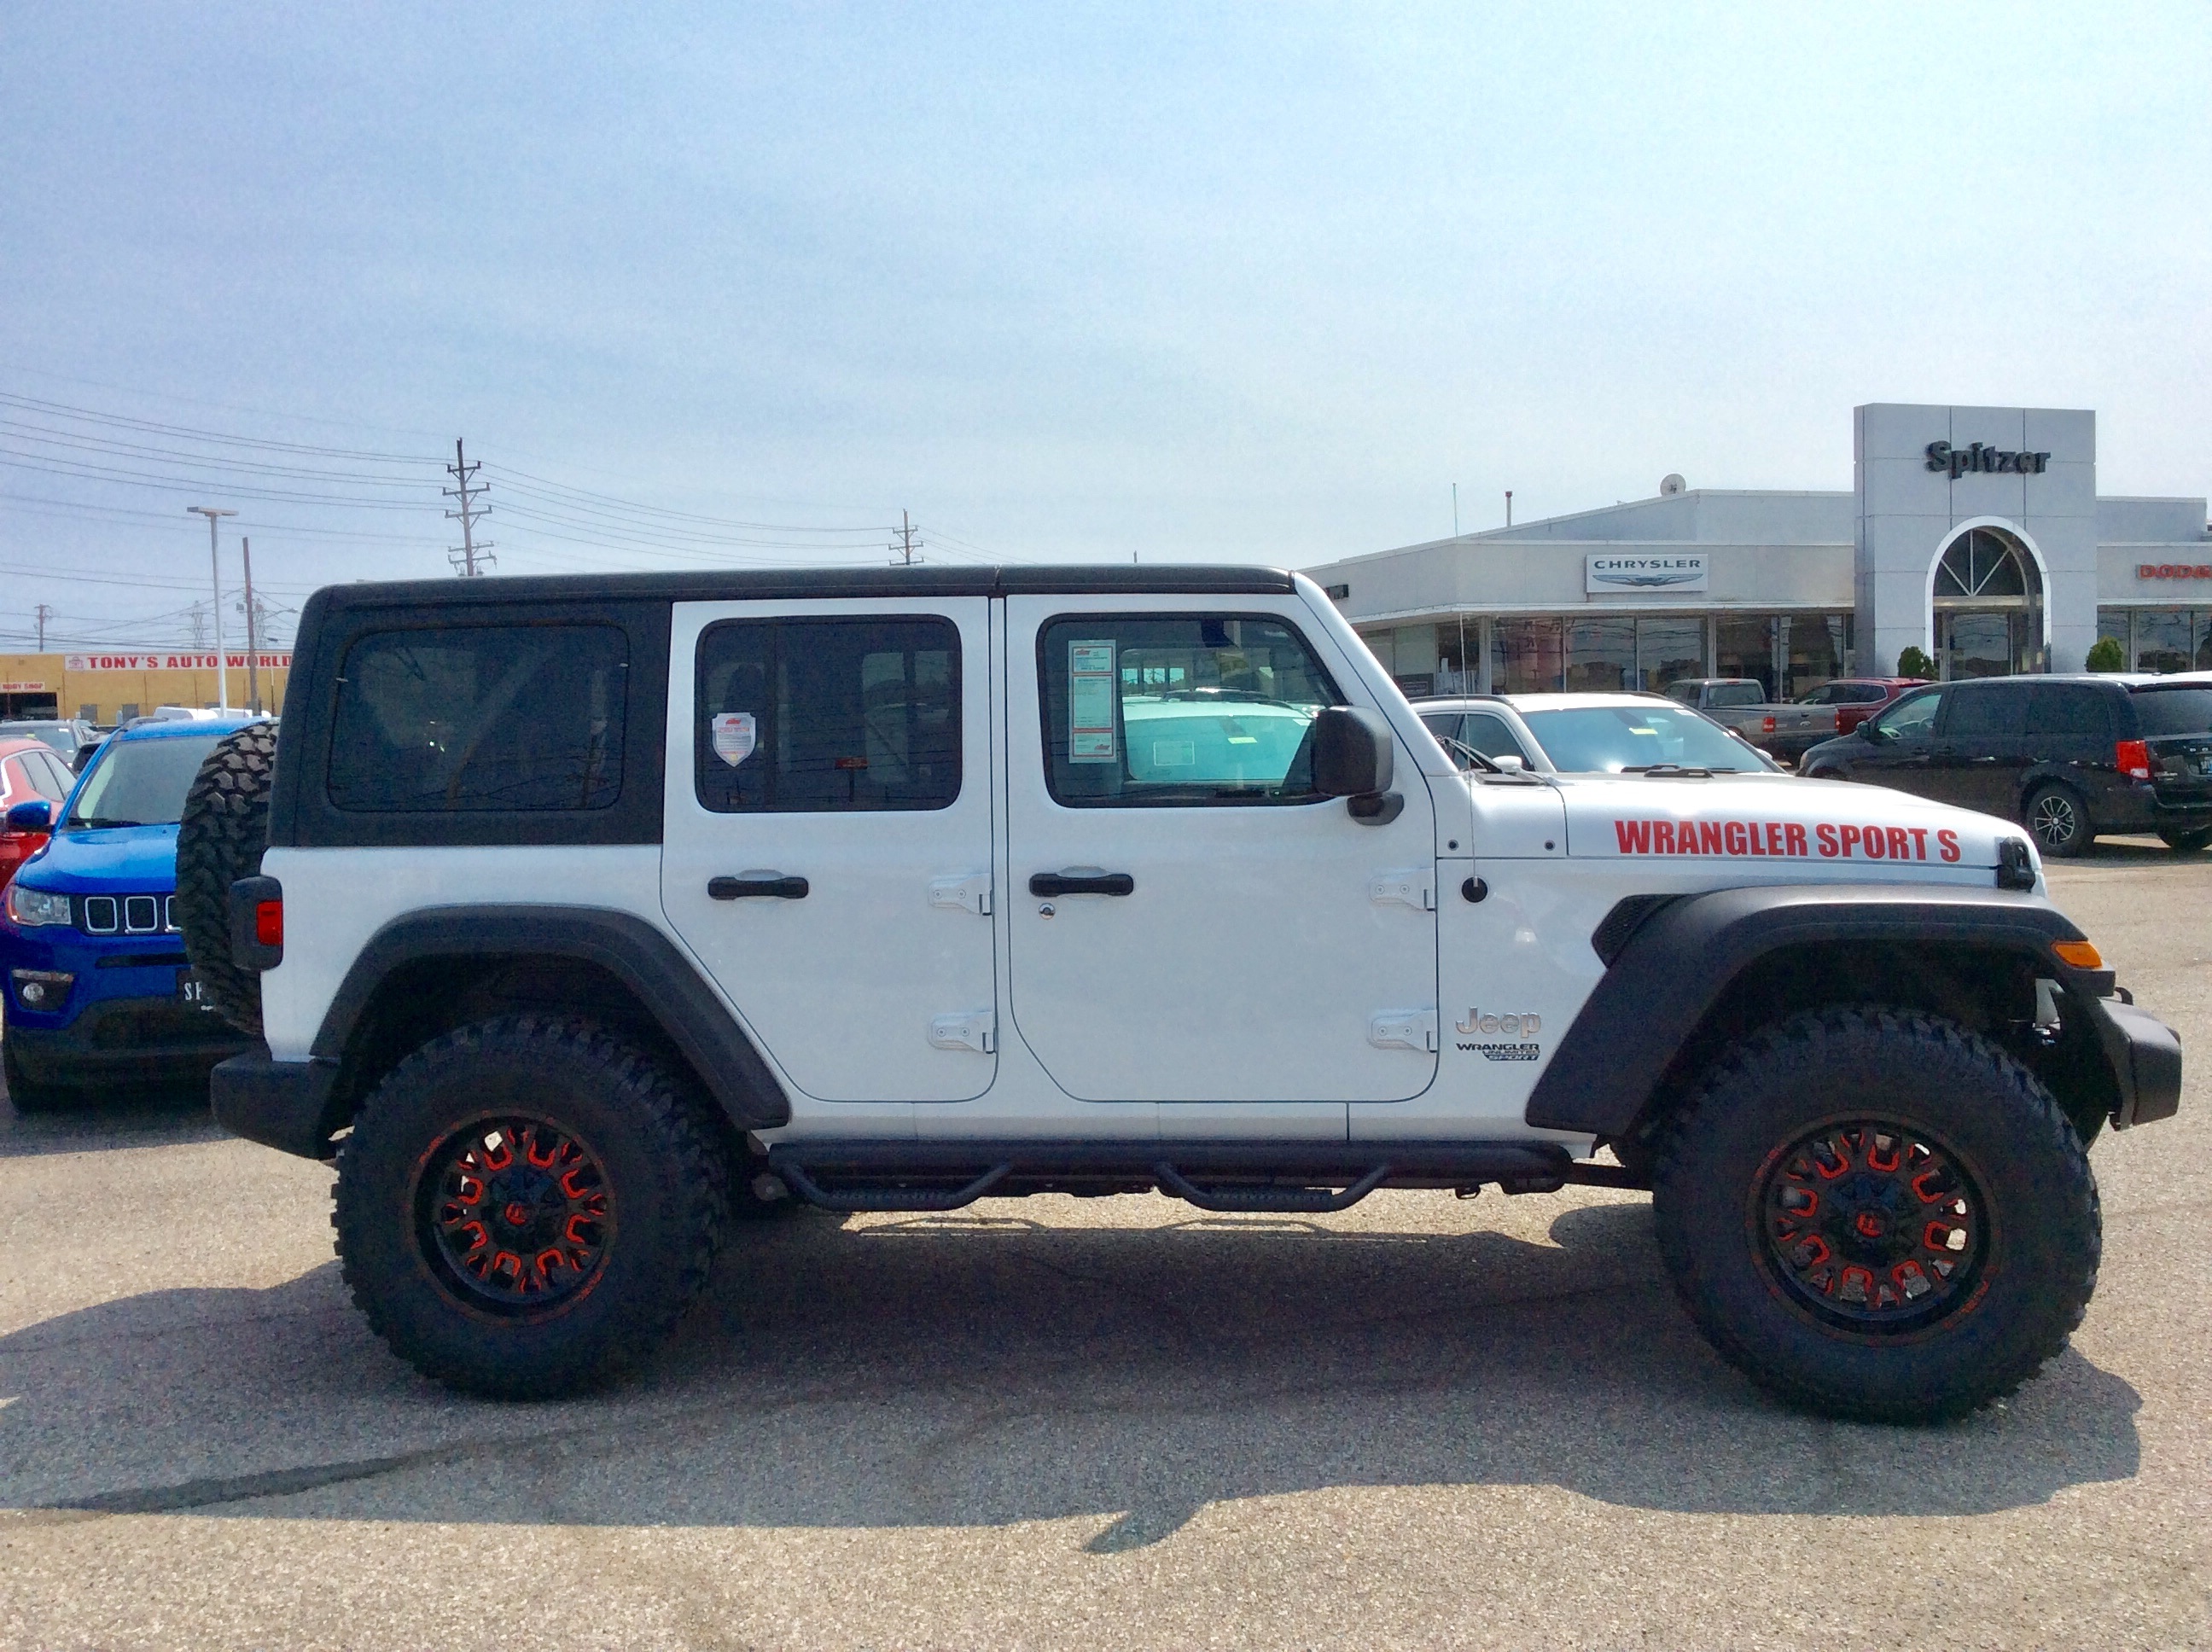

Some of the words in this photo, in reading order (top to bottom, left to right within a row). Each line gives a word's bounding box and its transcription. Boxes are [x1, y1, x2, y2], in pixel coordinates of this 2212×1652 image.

[1925, 440, 2051, 480] Spitzer
[1593, 559, 1701, 570] CHRYSLER
[87, 655, 159, 669] TONY'S
[166, 655, 218, 668] AUTO
[1614, 820, 1808, 857] WRANGLER
[1815, 823, 1929, 862] SPORT
[1936, 829, 1962, 863] S
[1455, 1006, 1541, 1038] Jeep
[1455, 1043, 1540, 1051] WRANGLER
